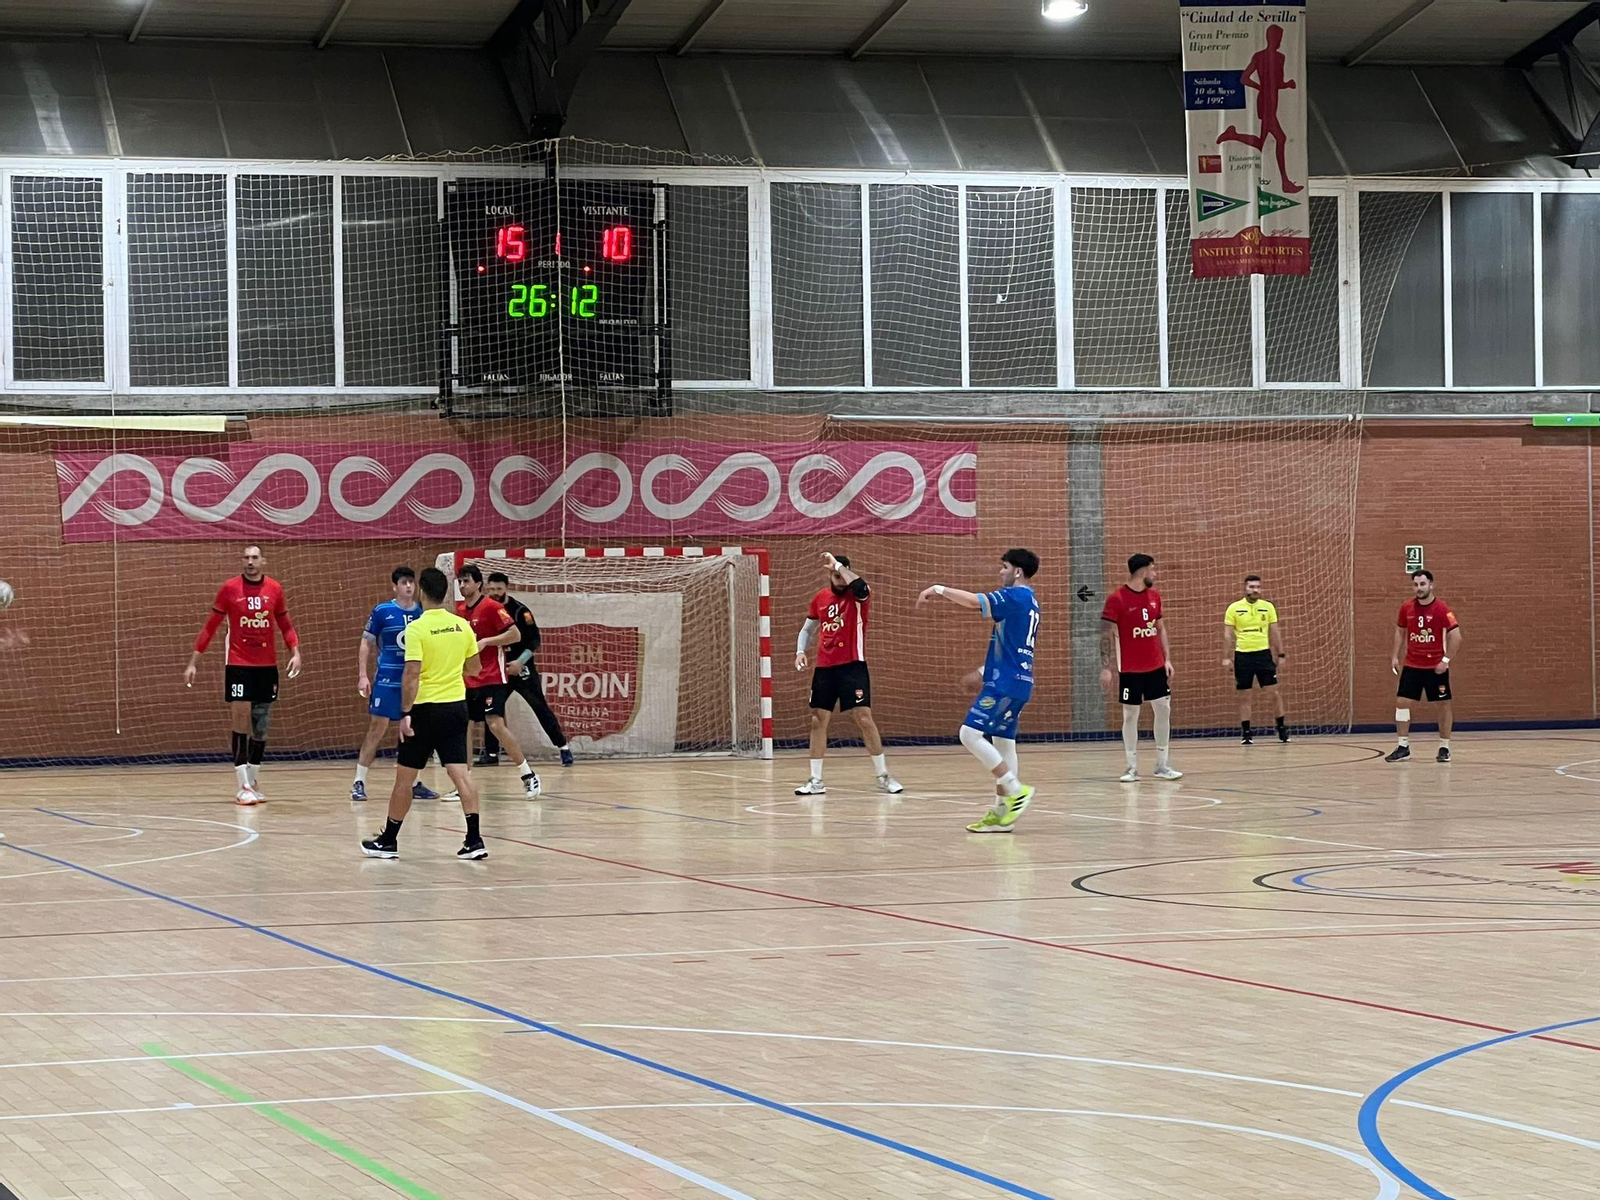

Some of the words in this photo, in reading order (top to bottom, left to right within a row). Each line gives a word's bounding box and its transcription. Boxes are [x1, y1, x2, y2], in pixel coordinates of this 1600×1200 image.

[1238, 11, 1253, 23] de
[1188, 30, 1213, 40] Gran
[1216, 30, 1249, 40] Premio
[1189, 42, 1231, 53] Hipercor
[1195, 87, 1205, 95] 10
[1206, 87, 1215, 95] de
[485, 205, 514, 216] LOCAL
[583, 205, 629, 216] VISITANTE
[496, 226, 526, 261] 15
[602, 226, 632, 260] 10
[1198, 245, 1253, 258] INSTITUTO
[483, 373, 510, 381] FALTAS
[599, 372, 625, 381] FALTAS
[247, 596, 261, 610] 39
[828, 603, 839, 618] 21
[1142, 607, 1149, 621] 6
[239, 610, 270, 628] Proin
[1418, 615, 1424, 628] 3
[231, 683, 244, 697] 39
[541, 672, 630, 699] PROIN
[1122, 687, 1130, 701] 6
[558, 704, 610, 717] TRIANA
